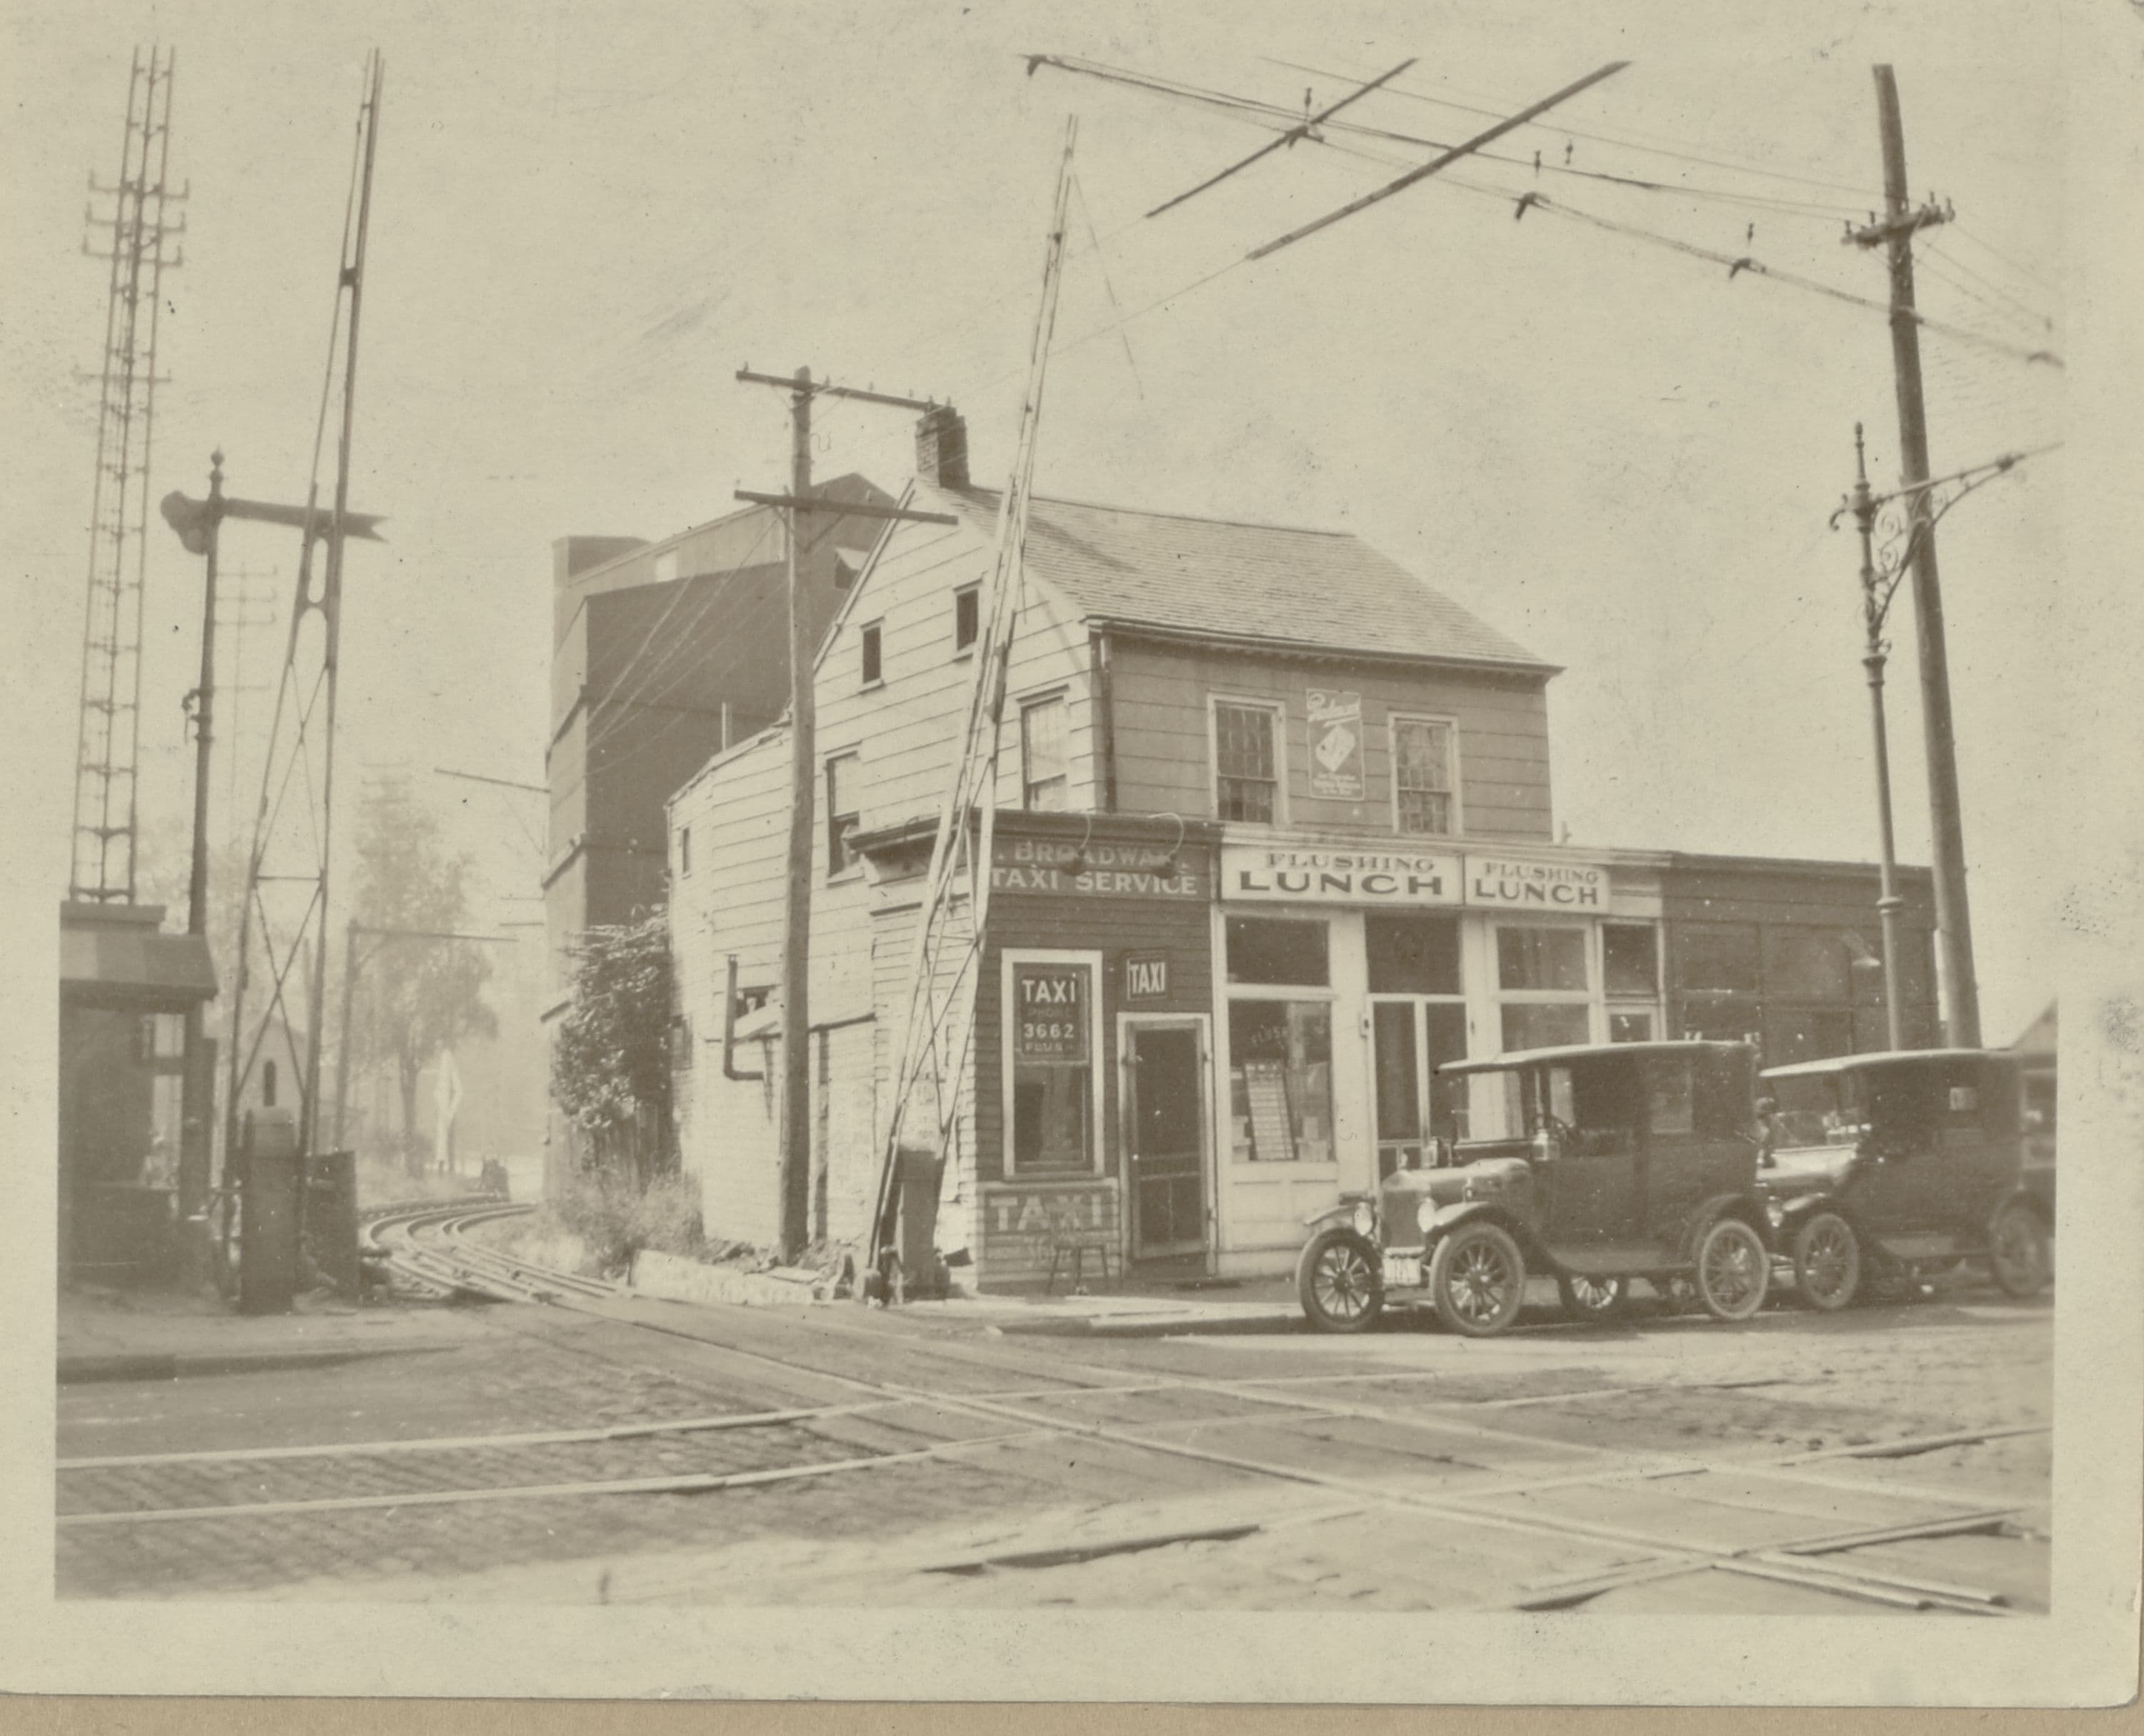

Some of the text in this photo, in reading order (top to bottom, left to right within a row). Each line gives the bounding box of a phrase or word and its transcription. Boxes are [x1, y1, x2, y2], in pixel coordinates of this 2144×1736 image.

[1266, 852, 1434, 872] FLUSHING
[991, 867, 1197, 894] TAXI SERVICE
[1240, 870, 1442, 895] LUNCH
[1475, 878, 1597, 905] LUNCH
[1022, 979, 1075, 1003] TAXI
[1130, 962, 1165, 994] TAXI
[1024, 1022, 1075, 1039] 3662
[989, 1194, 1102, 1231] TAXI
